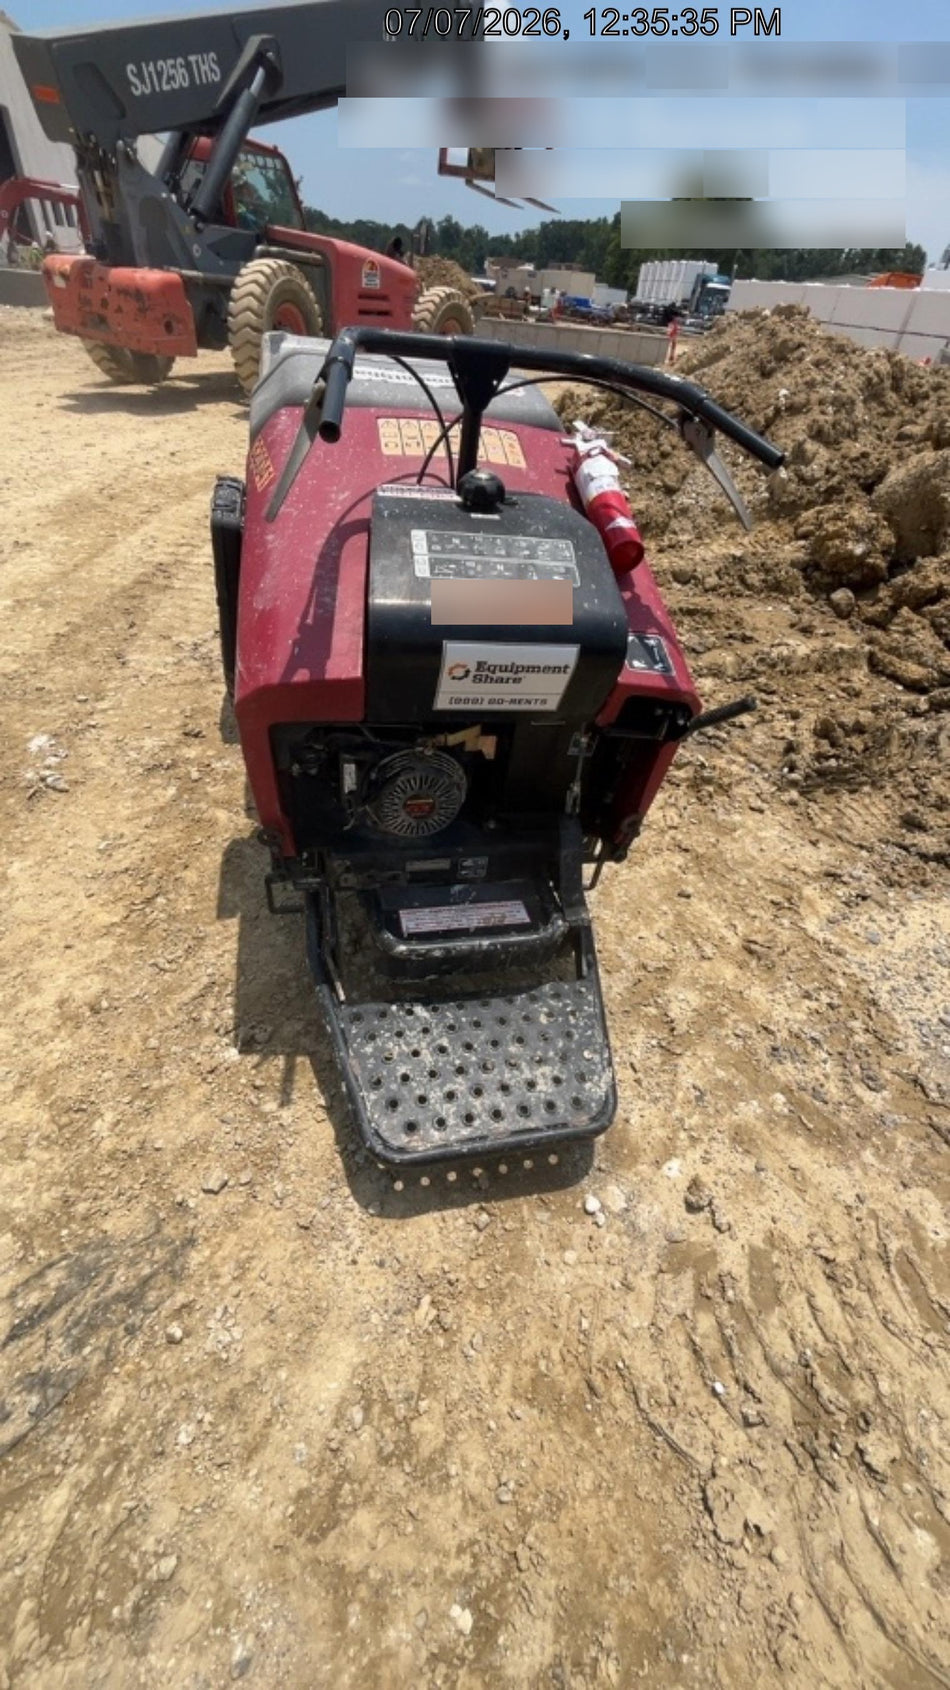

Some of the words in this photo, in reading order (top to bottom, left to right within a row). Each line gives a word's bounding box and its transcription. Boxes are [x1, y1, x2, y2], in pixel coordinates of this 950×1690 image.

[126, 56, 189, 97] SJ1256
[187, 52, 222, 85] THS
[474, 660, 571, 675] Equipment
[472, 673, 522, 685] Share
